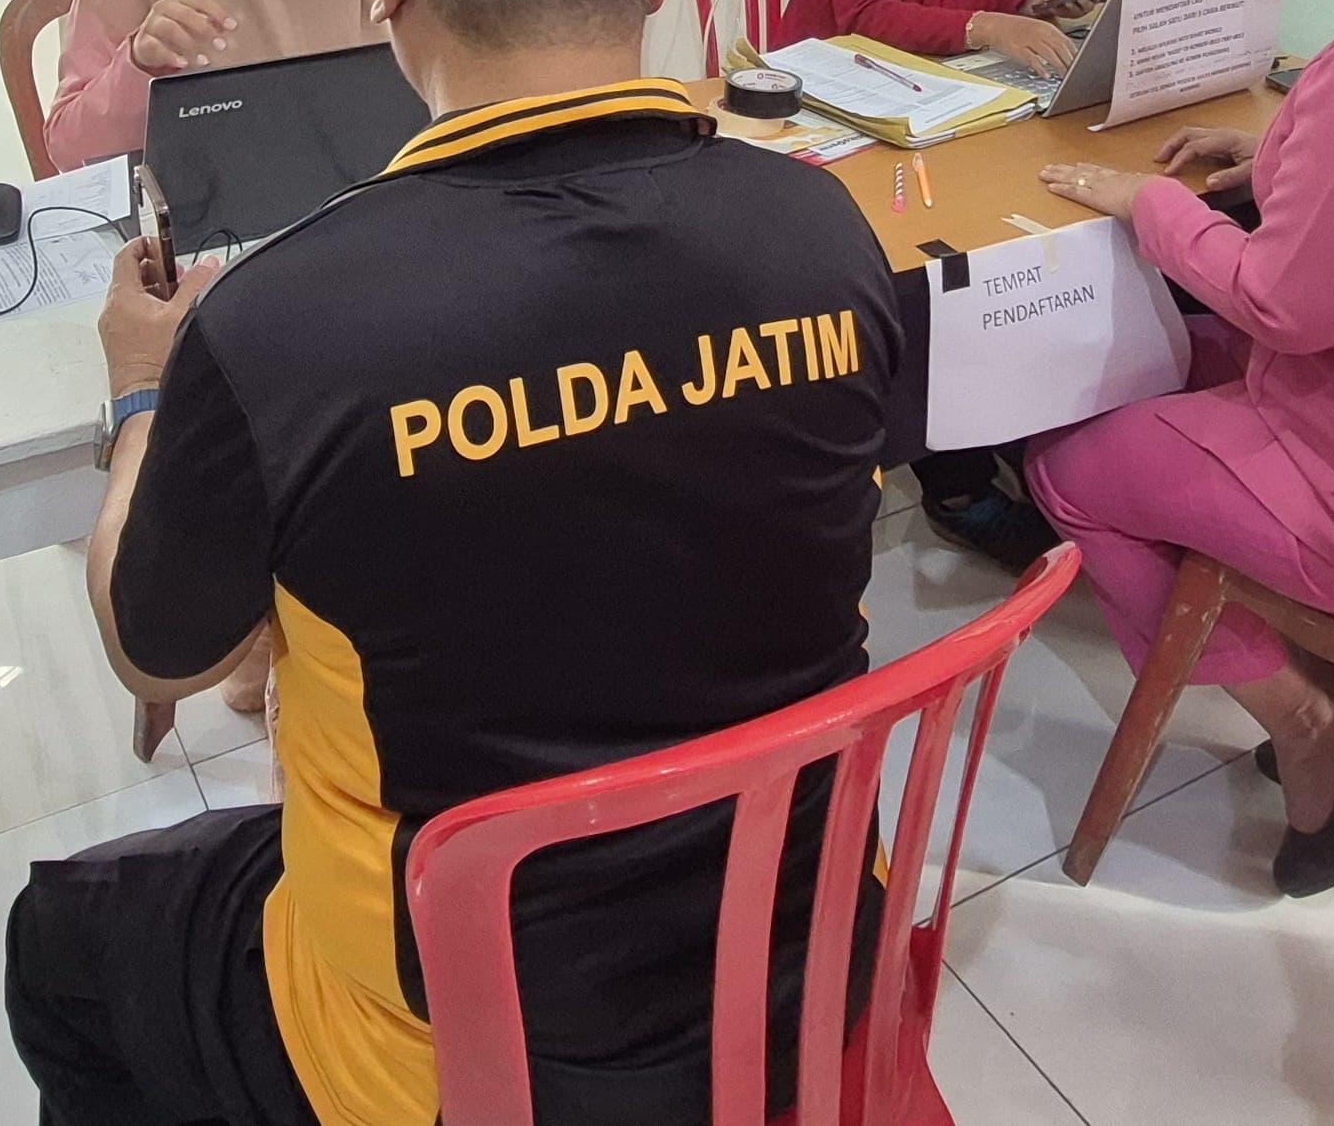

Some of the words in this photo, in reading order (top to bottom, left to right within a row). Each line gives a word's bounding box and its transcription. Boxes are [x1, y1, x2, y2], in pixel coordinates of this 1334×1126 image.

[178, 98, 243, 119] Lenovo
[983, 266, 1042, 297] TEMPAT
[983, 284, 1095, 330] PENDAFTARAN
[390, 350, 668, 477] POLDA
[682, 310, 859, 406] JATIM
